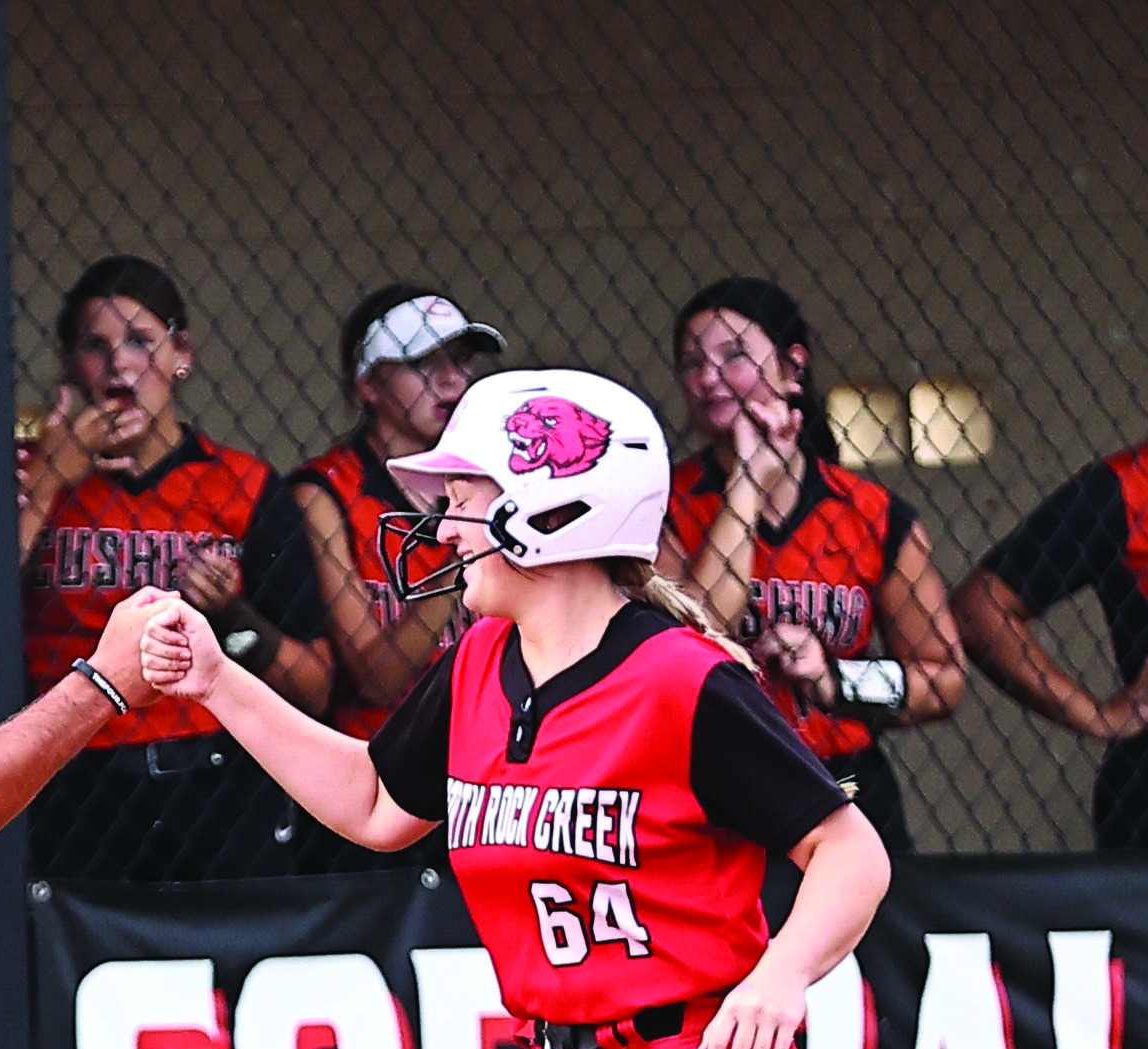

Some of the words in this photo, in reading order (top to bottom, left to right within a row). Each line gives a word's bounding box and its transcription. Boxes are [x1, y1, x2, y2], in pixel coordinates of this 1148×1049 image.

[481, 784, 540, 847] ROCK
[532, 787, 643, 868] CREEK
[530, 880, 651, 966] 64
